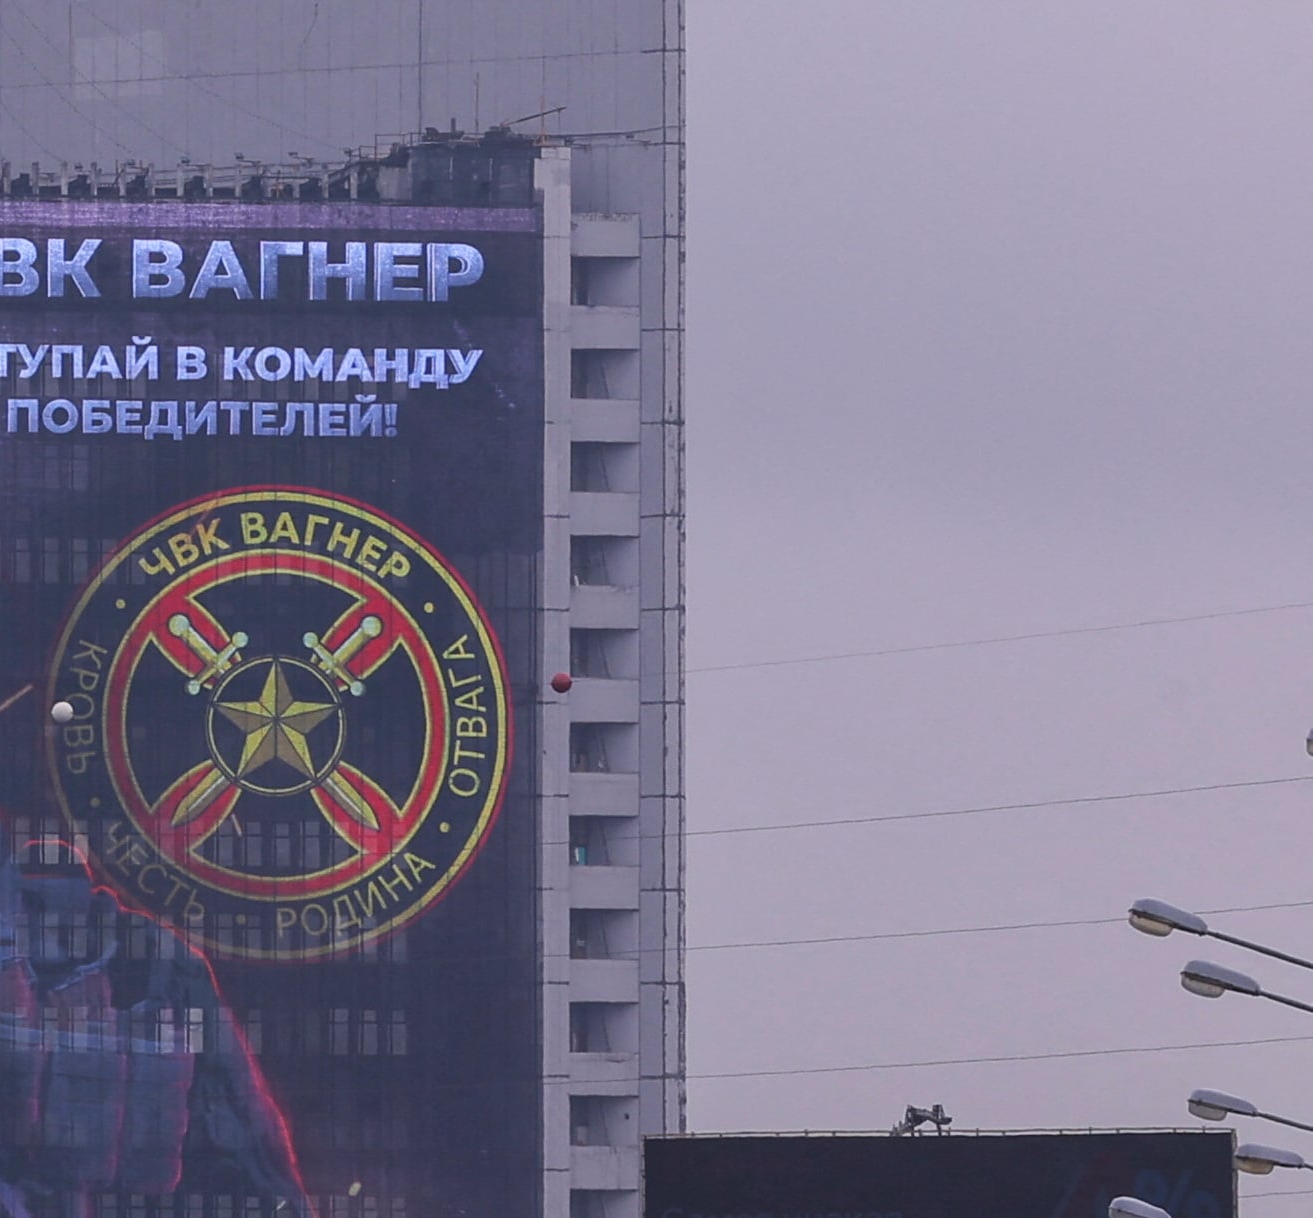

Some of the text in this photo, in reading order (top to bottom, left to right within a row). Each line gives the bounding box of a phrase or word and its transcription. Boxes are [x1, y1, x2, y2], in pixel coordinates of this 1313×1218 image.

[132, 239, 485, 302] ВАГНЕР
[177, 346, 208, 382] В
[223, 345, 483, 389] КОМАНДУ
[6, 394, 398, 440] ПОБЕДИТЕЛЕЙ!
[139, 511, 411, 583] ЧВК ВАГНЕР
[64, 638, 108, 775] КРОВЬ
[442, 634, 488, 797] ОТВАГА
[107, 820, 206, 920] ЧЕСТЬ
[276, 850, 436, 938] РОДИНА
